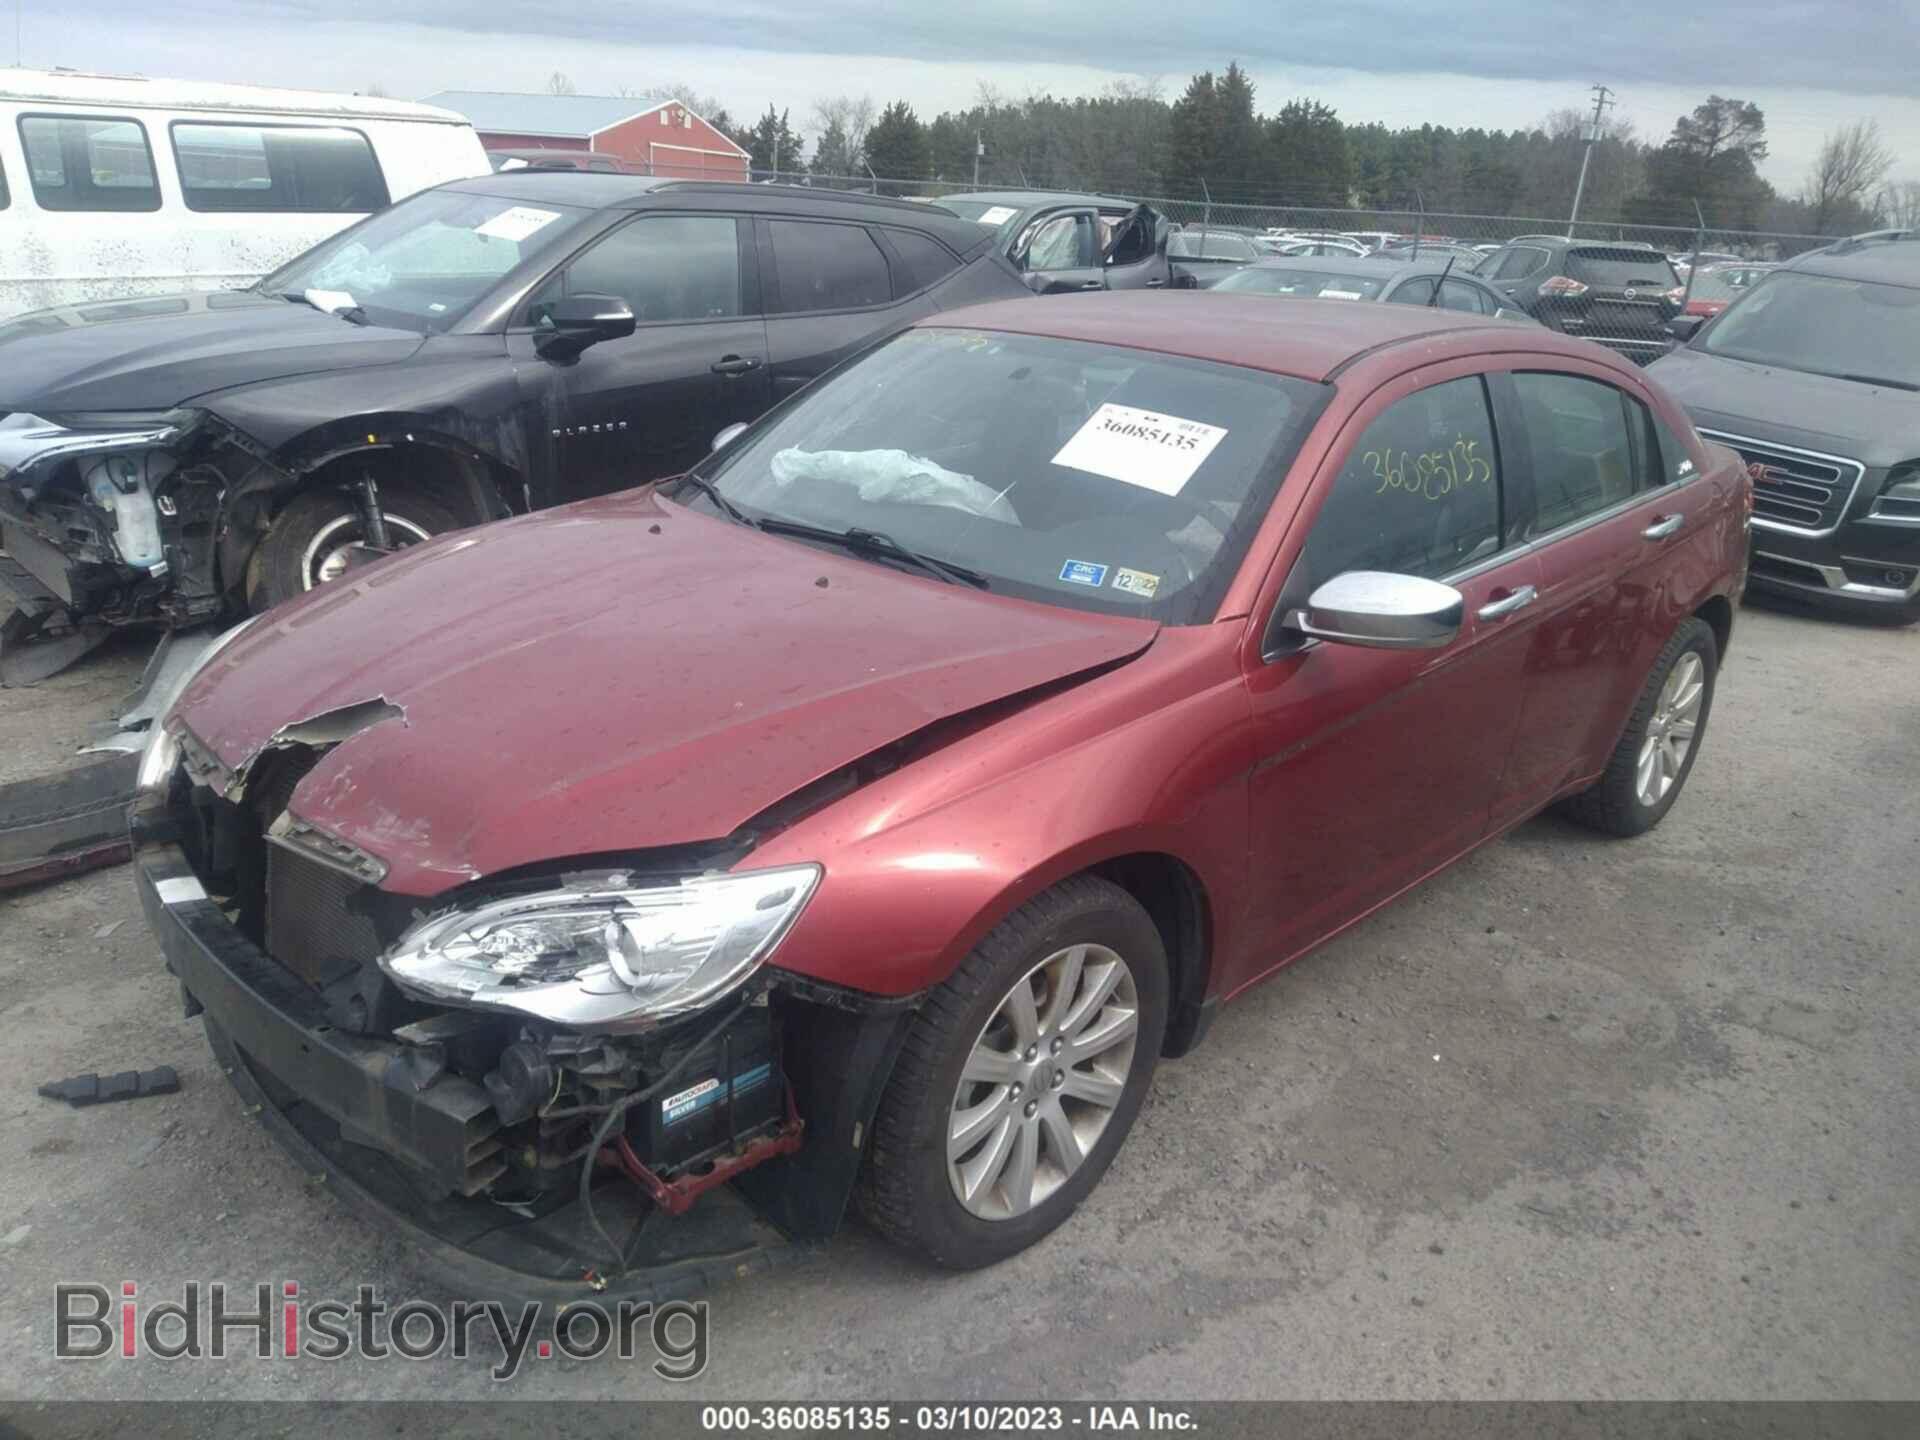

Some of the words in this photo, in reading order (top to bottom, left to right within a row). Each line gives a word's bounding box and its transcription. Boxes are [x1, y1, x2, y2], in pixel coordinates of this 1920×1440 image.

[1096, 418, 1200, 450] 36085135
[1362, 433, 1490, 500] 36085135
[1118, 573, 1132, 588] 12
